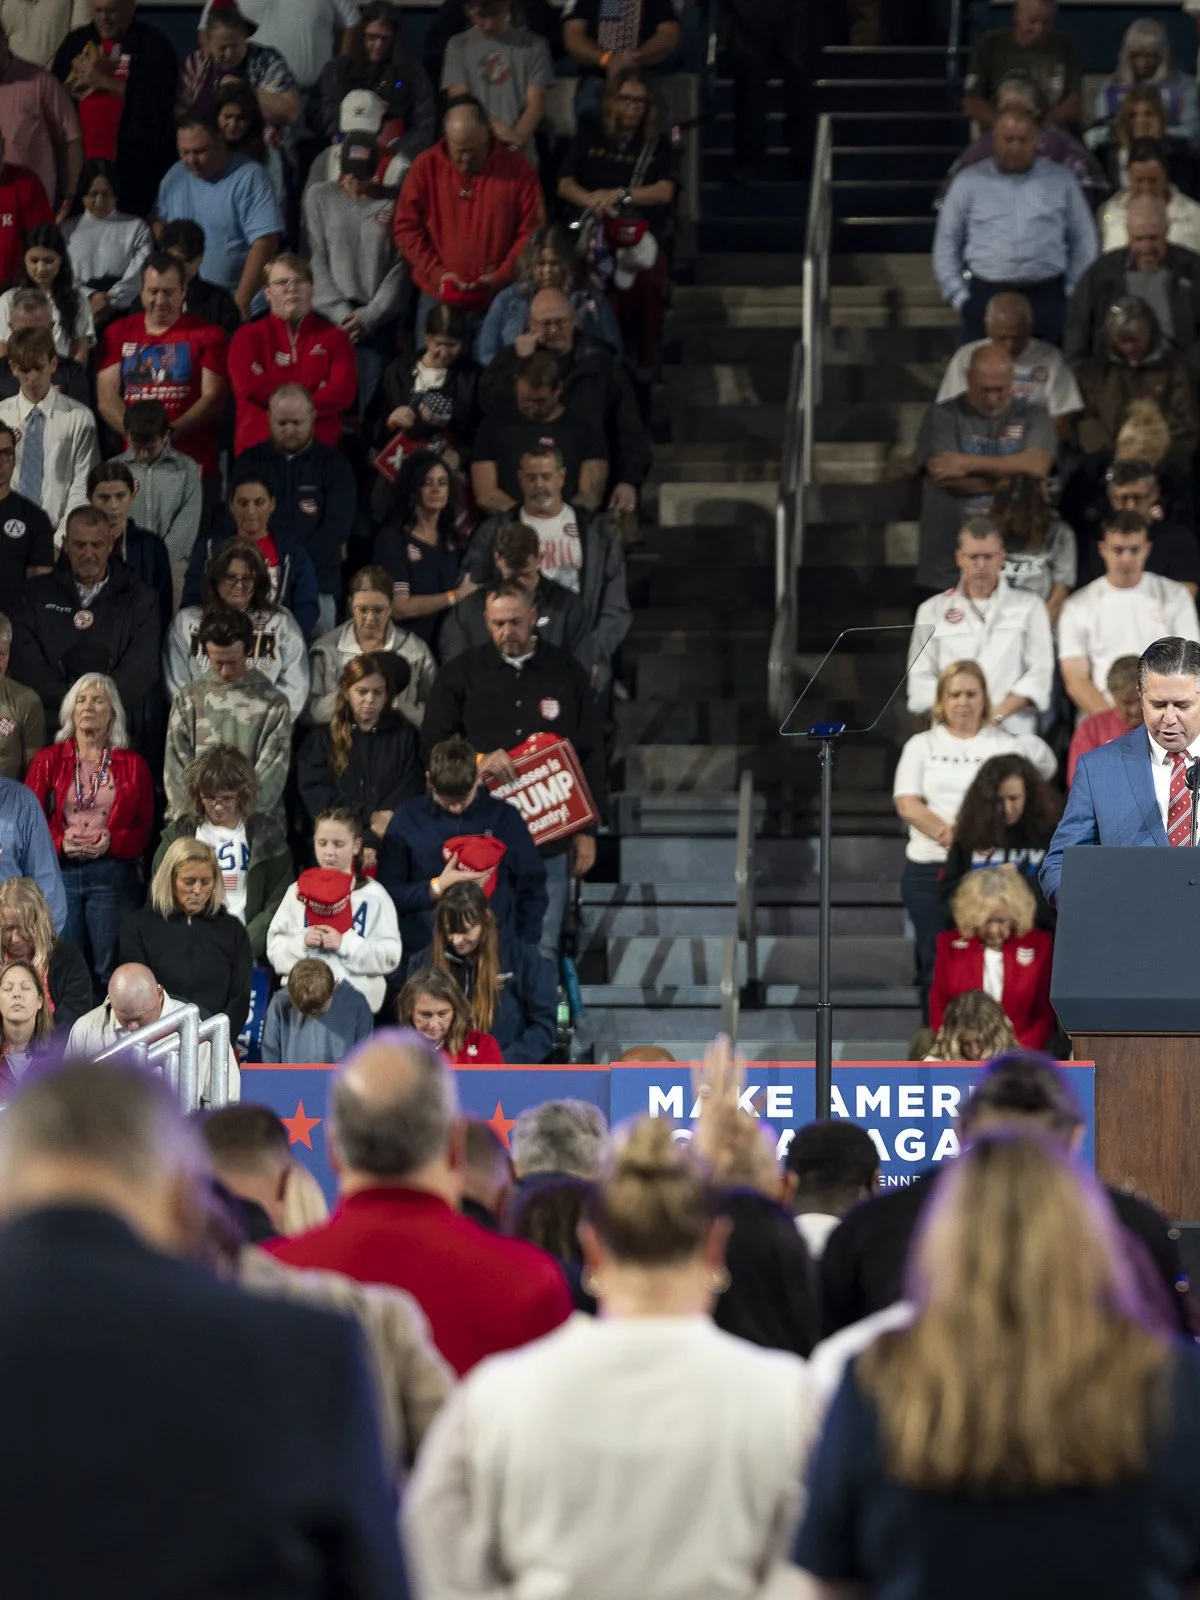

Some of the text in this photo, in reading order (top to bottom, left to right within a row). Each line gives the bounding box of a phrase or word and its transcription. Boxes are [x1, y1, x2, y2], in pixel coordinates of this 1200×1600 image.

[489, 764, 550, 800] ennessee
[505, 771, 573, 822] RUMP
[527, 804, 571, 834] ountry!
[218, 840, 250, 871] SA
[648, 1085, 975, 1118] MKE AMER
